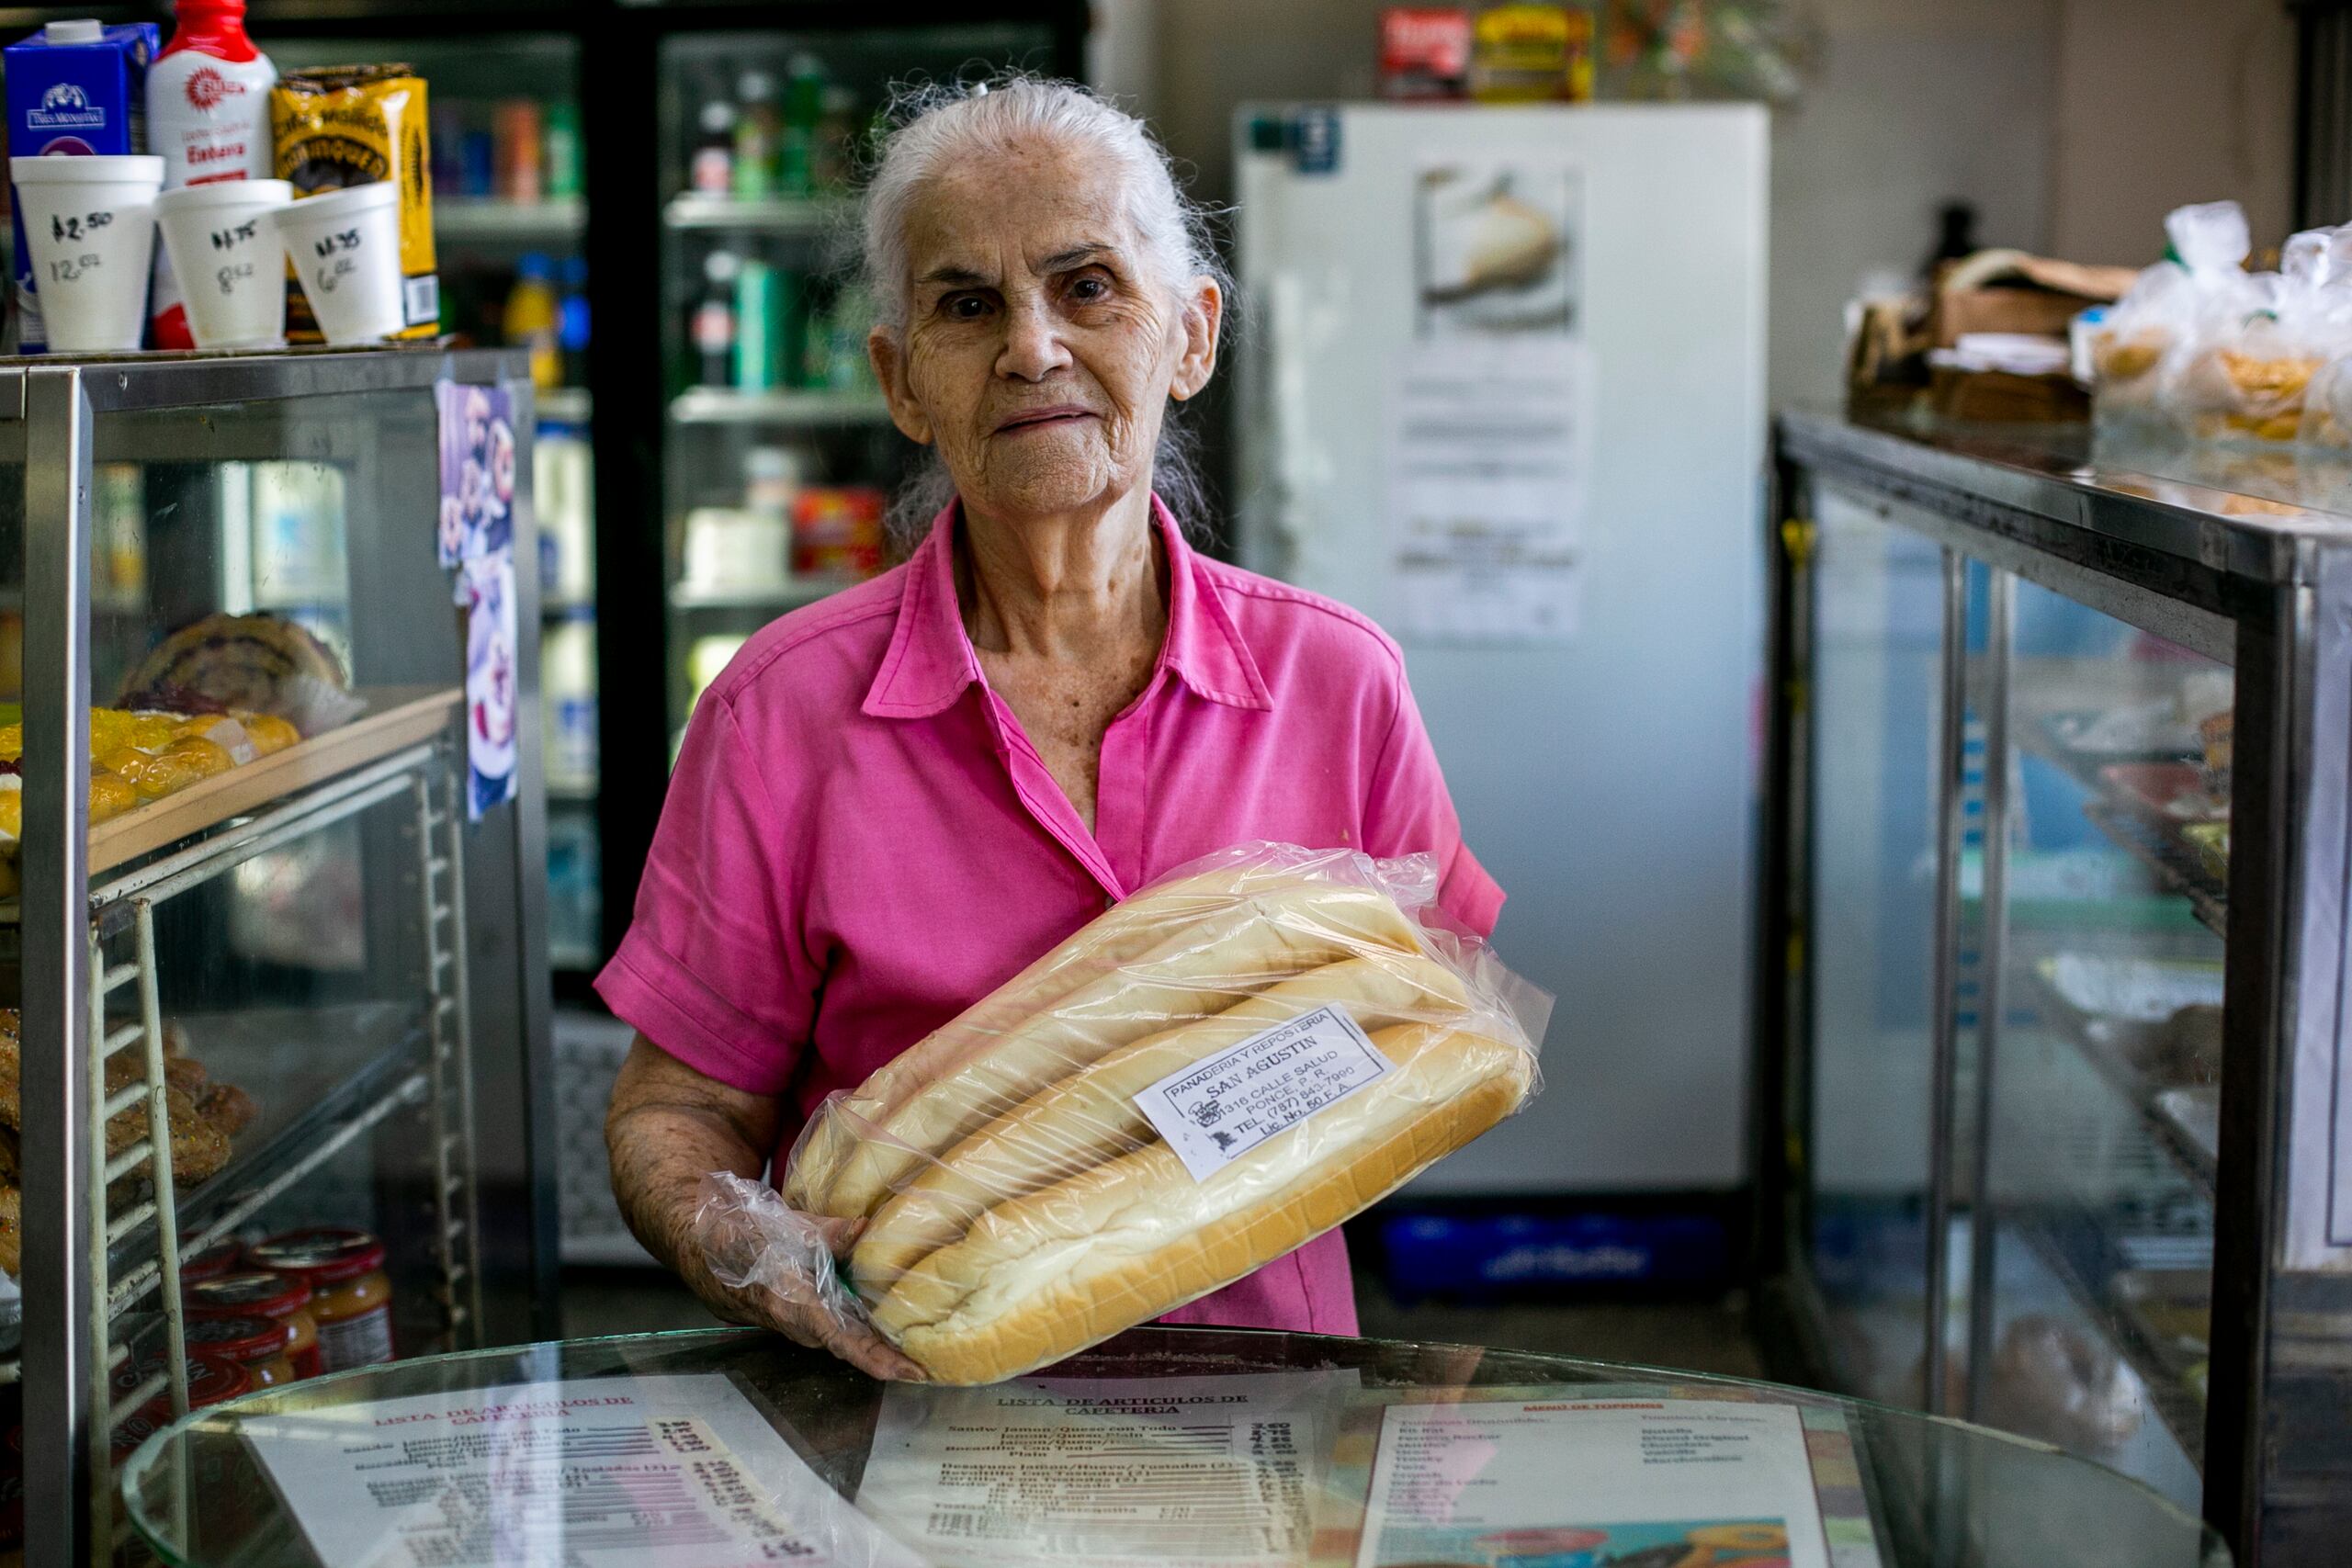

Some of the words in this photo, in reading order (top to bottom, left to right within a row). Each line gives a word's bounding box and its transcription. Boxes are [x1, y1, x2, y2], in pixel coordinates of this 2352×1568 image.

[1170, 1057, 1241, 1098] PANADERIA
[1238, 1050, 1250, 1059] Y
[1251, 1013, 1329, 1055] REPOSTERIA
[1206, 1073, 1243, 1099] SAN
[1246, 1036, 1318, 1078] AGUSTIN
[1219, 1098, 1250, 1117] 1316
[1250, 1073, 1294, 1100] CALLE
[1294, 1050, 1338, 1076] SALUD
[1246, 1085, 1299, 1114] PONCE,
[1314, 1067, 1329, 1078] R.
[1234, 1117, 1264, 1134] TEL.
[1267, 1097, 1300, 1118] (787)
[1283, 1109, 1306, 1122] No.
[1306, 1097, 1323, 1110] 50
[374, 1413, 436, 1427] LISTA
[604, 1396, 635, 1405] DE
[997, 1398, 1056, 1406] LISTA
[1066, 1398, 1093, 1406] DE
[1098, 1396, 1215, 1406] ARTICULOS
[1220, 1394, 1249, 1404] DE
[1065, 1406, 1181, 1416] CAFETERIA
